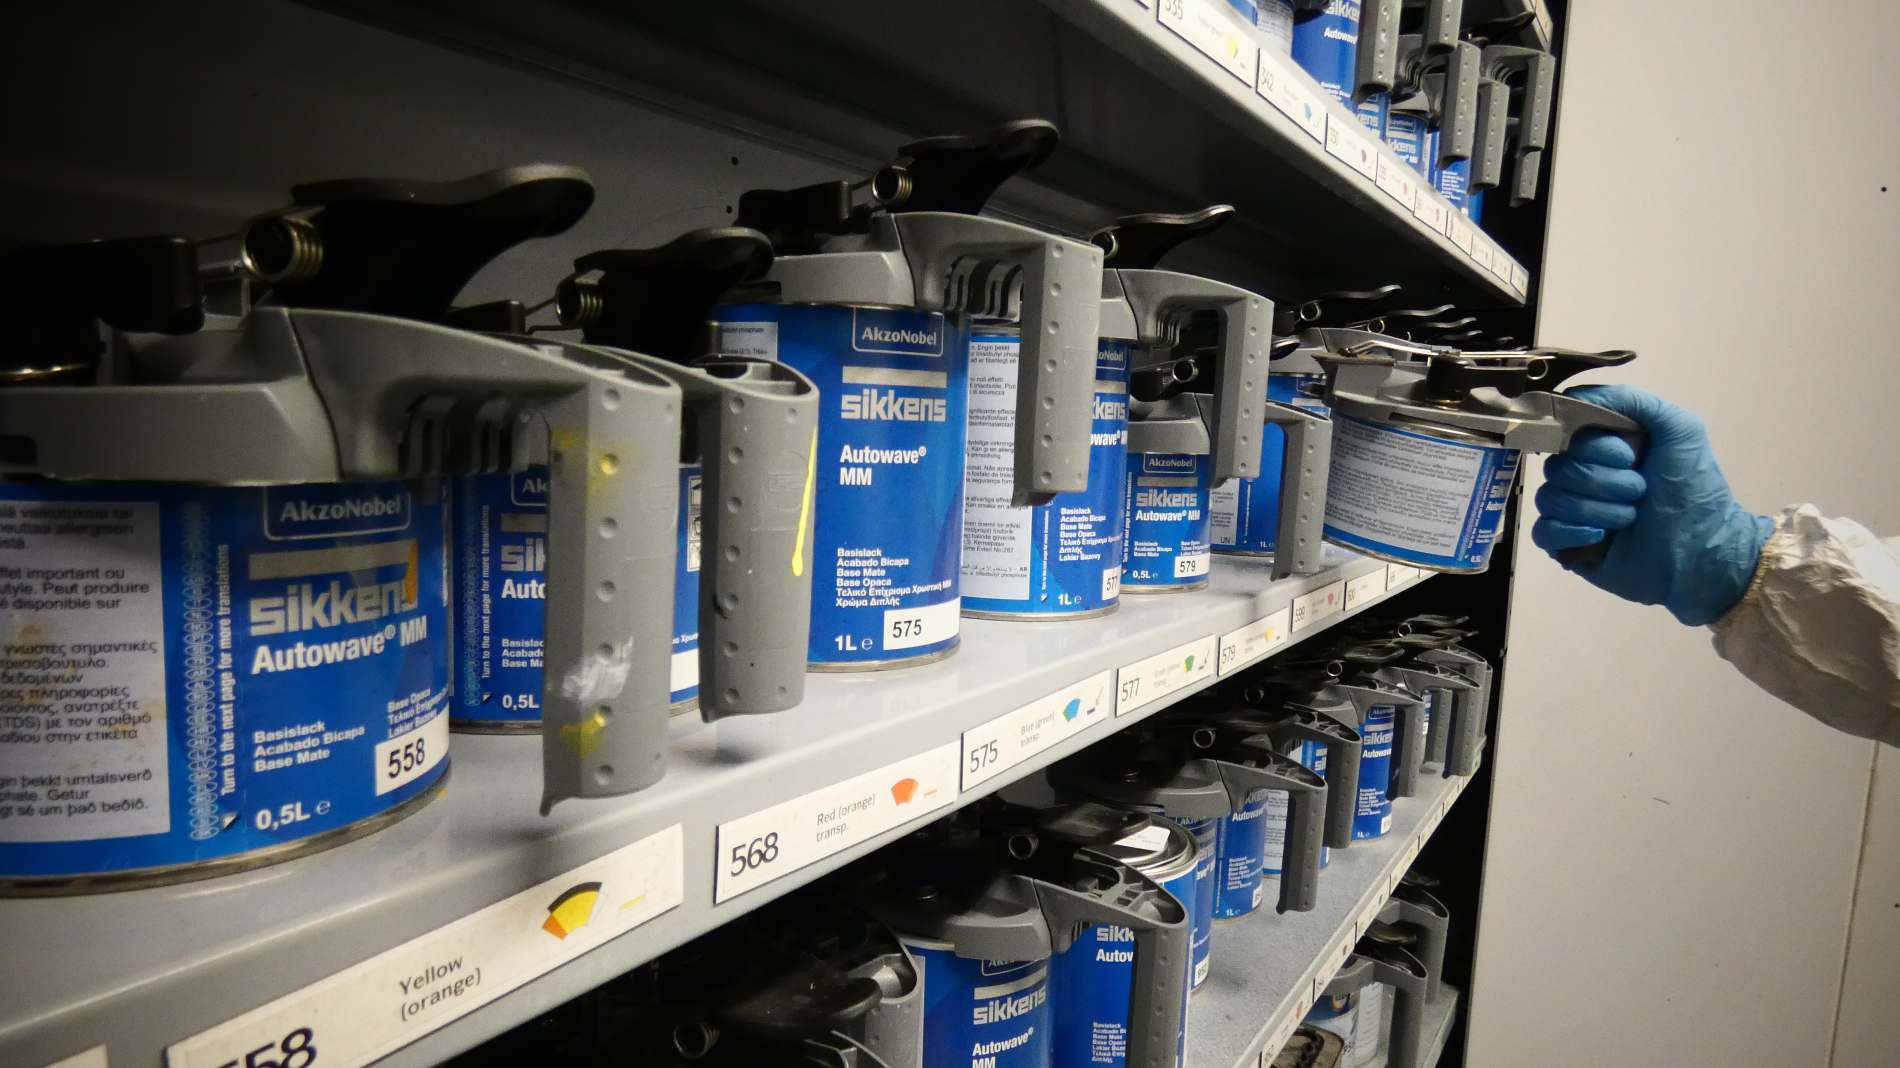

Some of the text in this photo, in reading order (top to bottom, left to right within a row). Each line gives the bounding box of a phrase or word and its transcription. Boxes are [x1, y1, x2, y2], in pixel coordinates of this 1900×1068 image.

[862, 327, 936, 346] AkzoNobel
[841, 388, 946, 422] sikkens
[1149, 458, 1193, 467] AkzoNobel
[840, 467, 872, 485] MM
[280, 493, 401, 522] AkzoNobel
[1136, 489, 1198, 507] sikkens
[837, 548, 882, 557] Basislack
[837, 557, 909, 567] Acabado Bicapa
[26, 567, 99, 582] important
[104, 569, 125, 579] ou
[837, 568, 886, 577] Base Mate
[1132, 570, 1151, 579] 0,5L
[1180, 560, 1196, 573] 579
[43, 582, 78, 595] Peut
[84, 582, 150, 596] produire
[836, 578, 892, 588] Base Opaca
[1106, 576, 1118, 591] 577
[13, 598, 122, 612] disponible sur
[1058, 593, 1072, 605] 1L
[218, 619, 232, 649] more
[400, 615, 427, 647] MM
[892, 619, 922, 638] 575
[502, 638, 544, 647] Basislac
[835, 635, 857, 650] 1L
[218, 653, 232, 670] for
[502, 658, 527, 668] Base
[1222, 644, 1236, 665] 579
[220, 672, 236, 701] page
[1122, 678, 1140, 702] 577
[502, 694, 539, 710] 0,5L
[220, 703, 235, 730] next
[253, 725, 365, 758] Acabado Bicapa
[254, 721, 326, 743] Basislack
[221, 732, 235, 752] the
[221, 753, 235, 767] to
[255, 749, 331, 773] Base Mate
[387, 737, 425, 779] 558
[969, 739, 998, 773] 575
[222, 767, 236, 796] Turn
[47, 788, 91, 801] Getur
[256, 801, 311, 831] 0,5L
[817, 793, 876, 826] Red (orange)
[816, 823, 848, 842] transp.
[730, 832, 779, 877] 568
[399, 956, 464, 996] Yellow
[401, 967, 481, 1022] (orange)
[973, 984, 1046, 1025] sikkens
[972, 1057, 996, 1068] MM
